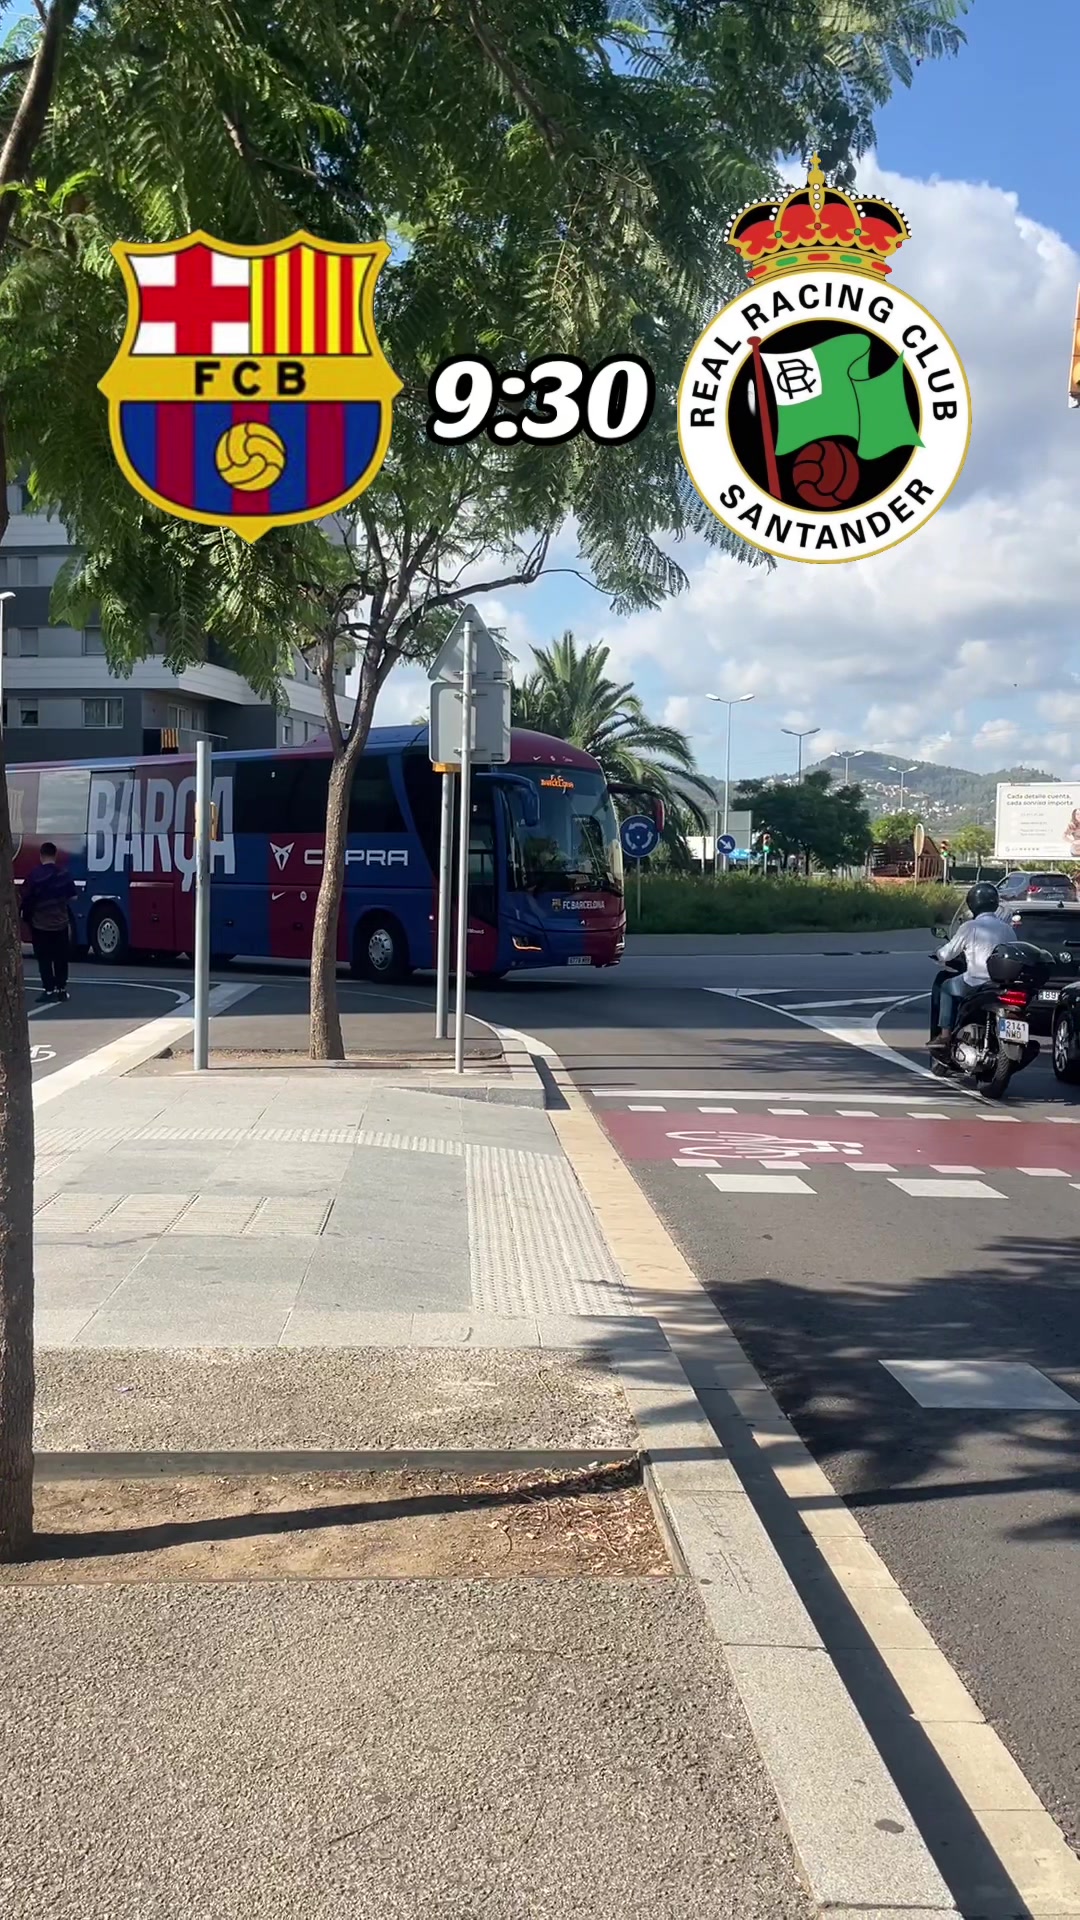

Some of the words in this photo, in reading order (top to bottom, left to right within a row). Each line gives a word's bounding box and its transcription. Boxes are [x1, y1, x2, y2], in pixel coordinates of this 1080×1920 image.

[87, 776, 236, 893] BARÇA
[304, 849, 409, 866] CPRA
[562, 900, 571, 910] FC
[571, 900, 605, 910] BARCELONA
[1006, 1020, 1026, 1032] 2141
